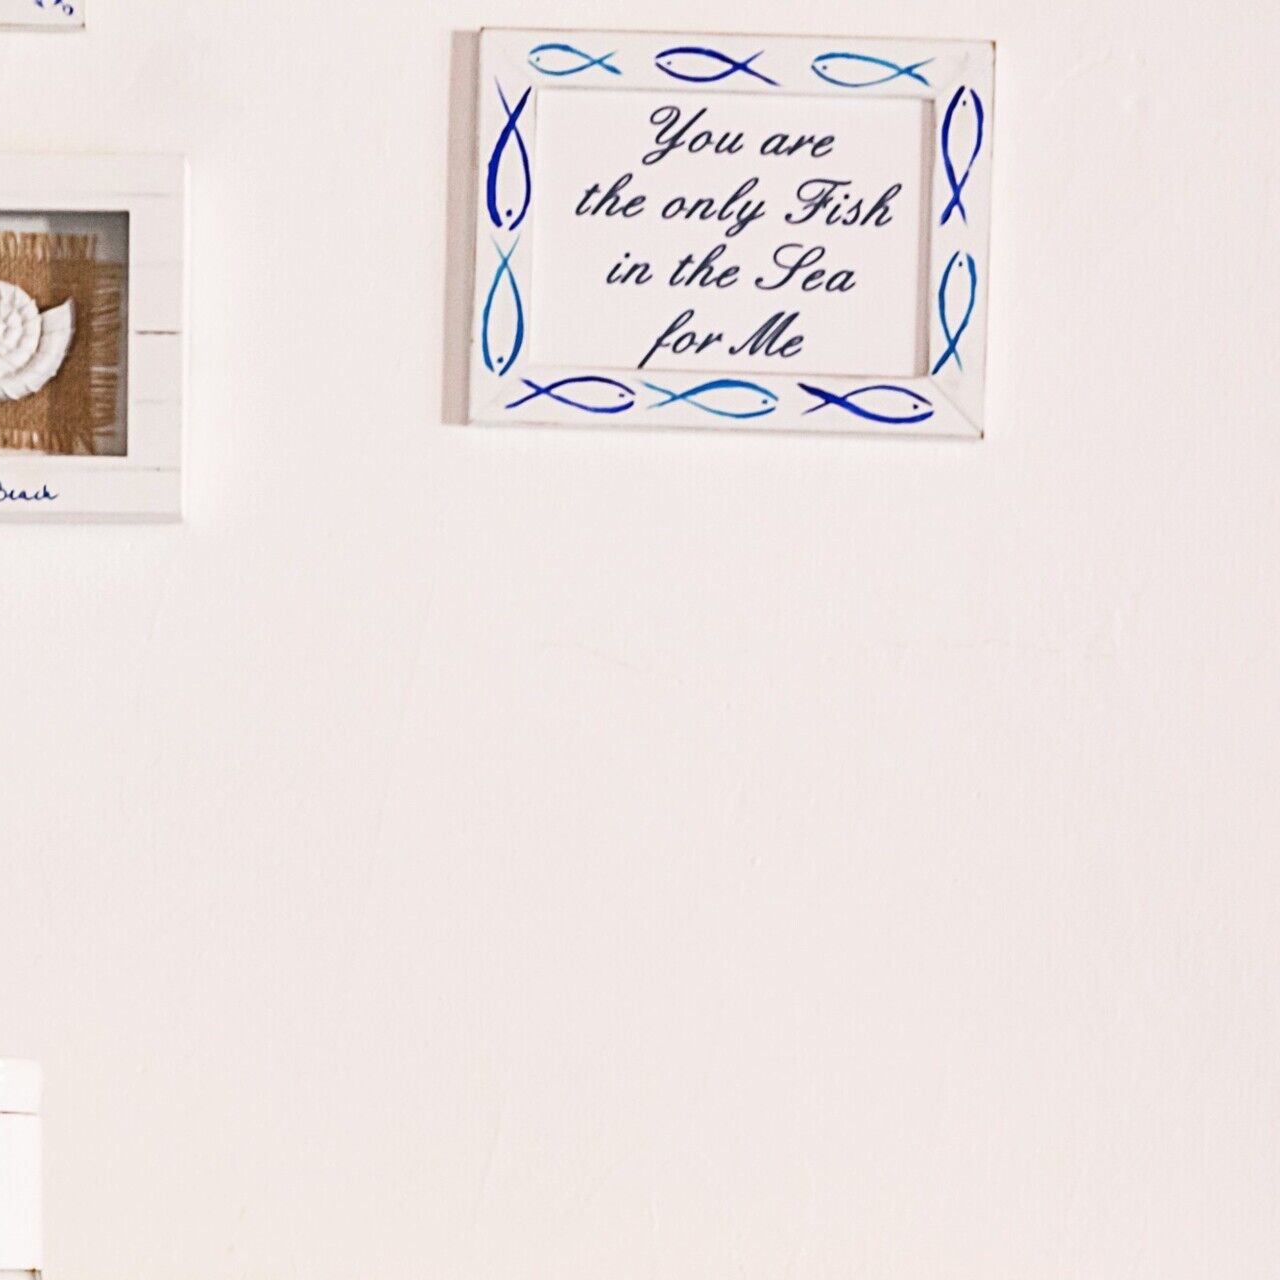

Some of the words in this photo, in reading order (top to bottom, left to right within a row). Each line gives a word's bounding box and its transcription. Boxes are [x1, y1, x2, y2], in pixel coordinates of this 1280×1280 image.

[642, 105, 743, 166] You
[760, 131, 836, 158] are
[574, 173, 645, 217] the
[661, 177, 766, 236] only
[784, 178, 902, 228] Fish
[606, 250, 652, 285] in
[669, 244, 739, 288] the
[755, 243, 856, 293] Sea
[637, 310, 722, 369] for
[729, 312, 804, 359] Me
